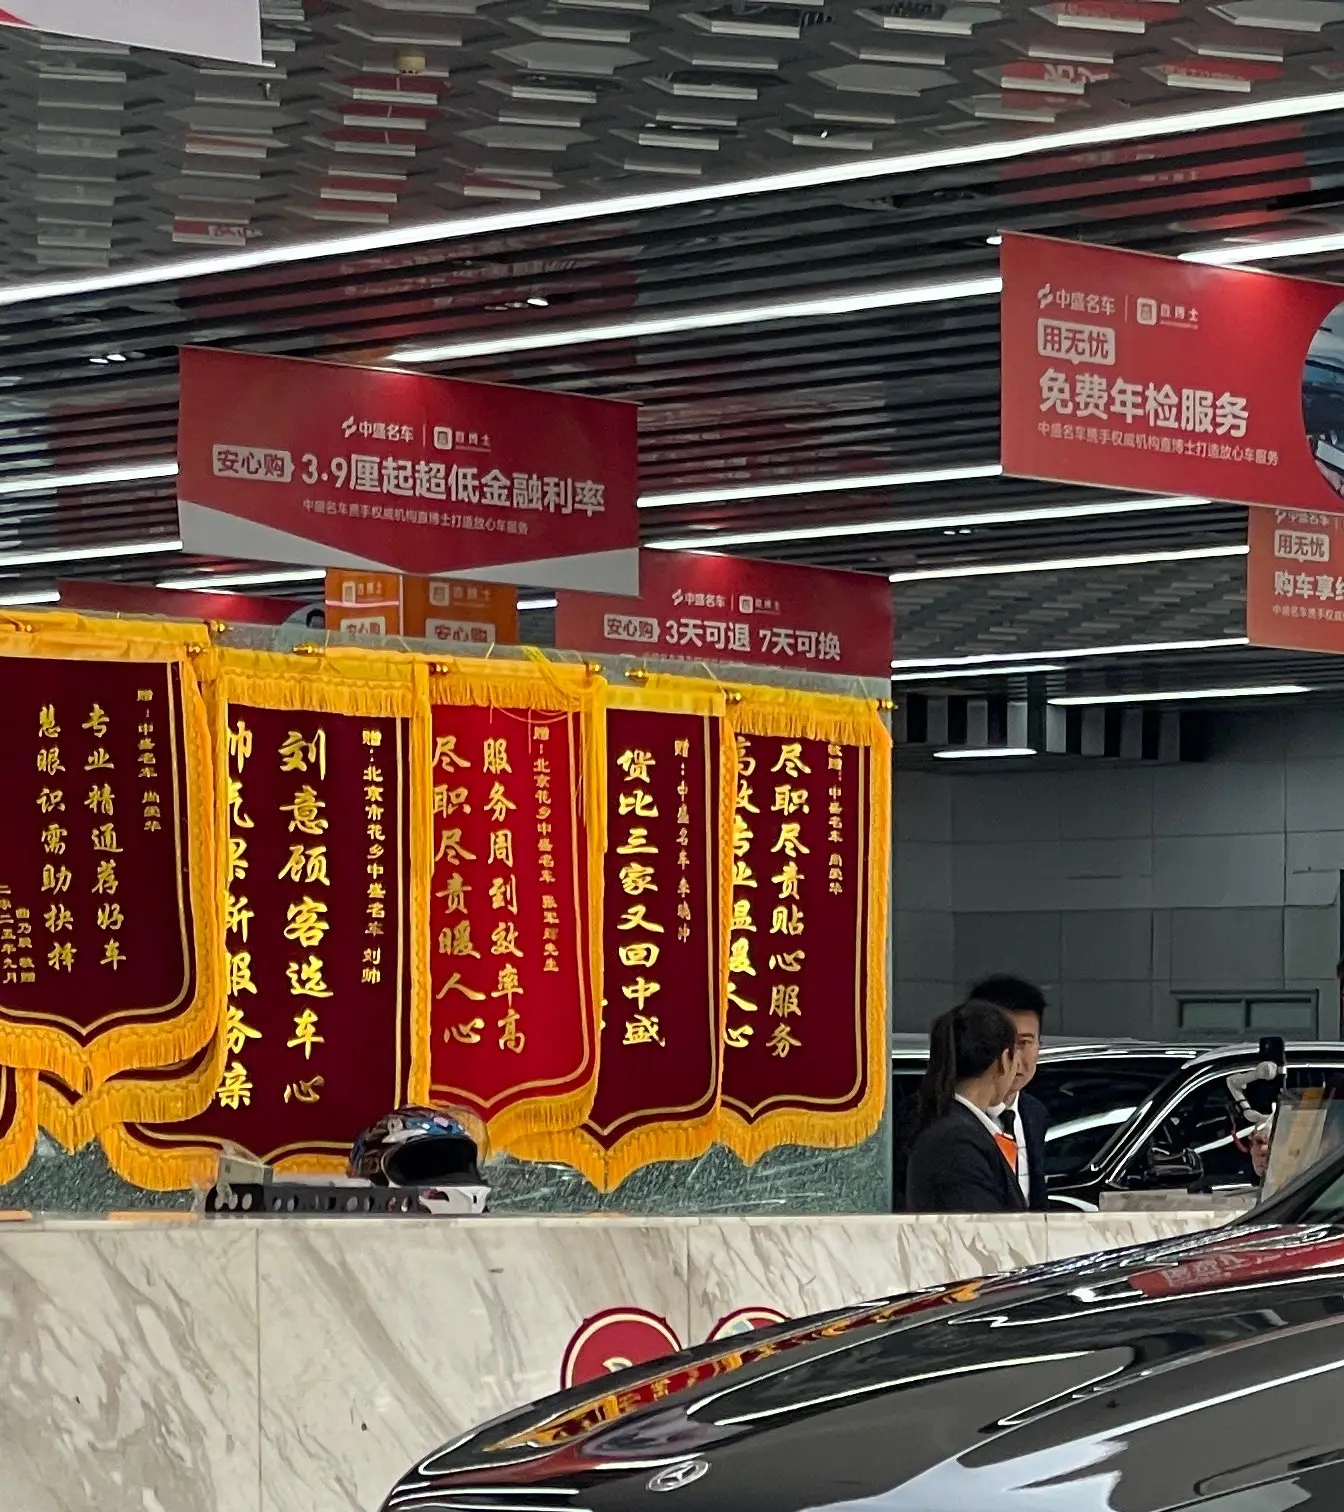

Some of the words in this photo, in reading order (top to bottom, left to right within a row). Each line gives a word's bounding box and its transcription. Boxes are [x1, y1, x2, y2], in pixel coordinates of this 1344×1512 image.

[1056, 289, 1115, 315] 中盛名车
[1043, 325, 1108, 358] 用无忧
[359, 421, 414, 442] 中盛名车
[1039, 368, 1248, 438] 免费年检服务
[217, 450, 285, 478] 安心购
[301, 453, 606, 518] 3.9厘起超低金融利率
[1278, 534, 1325, 558] 用无忧
[685, 592, 726, 608] 中盛名车
[607, 618, 654, 640] 安心购
[666, 618, 750, 651] 3天可退
[759, 628, 841, 662] 7天可换
[82, 703, 127, 971] 专业精通荐好车
[278, 727, 334, 1105] 刘意顾客选车心
[431, 735, 486, 1043] 尽职尽责暖人心
[483, 737, 526, 1054] 服务周到效率高
[616, 749, 666, 1048] 货比三家又回中盛
[766, 742, 812, 1058] 尽职尽责贴心服务
